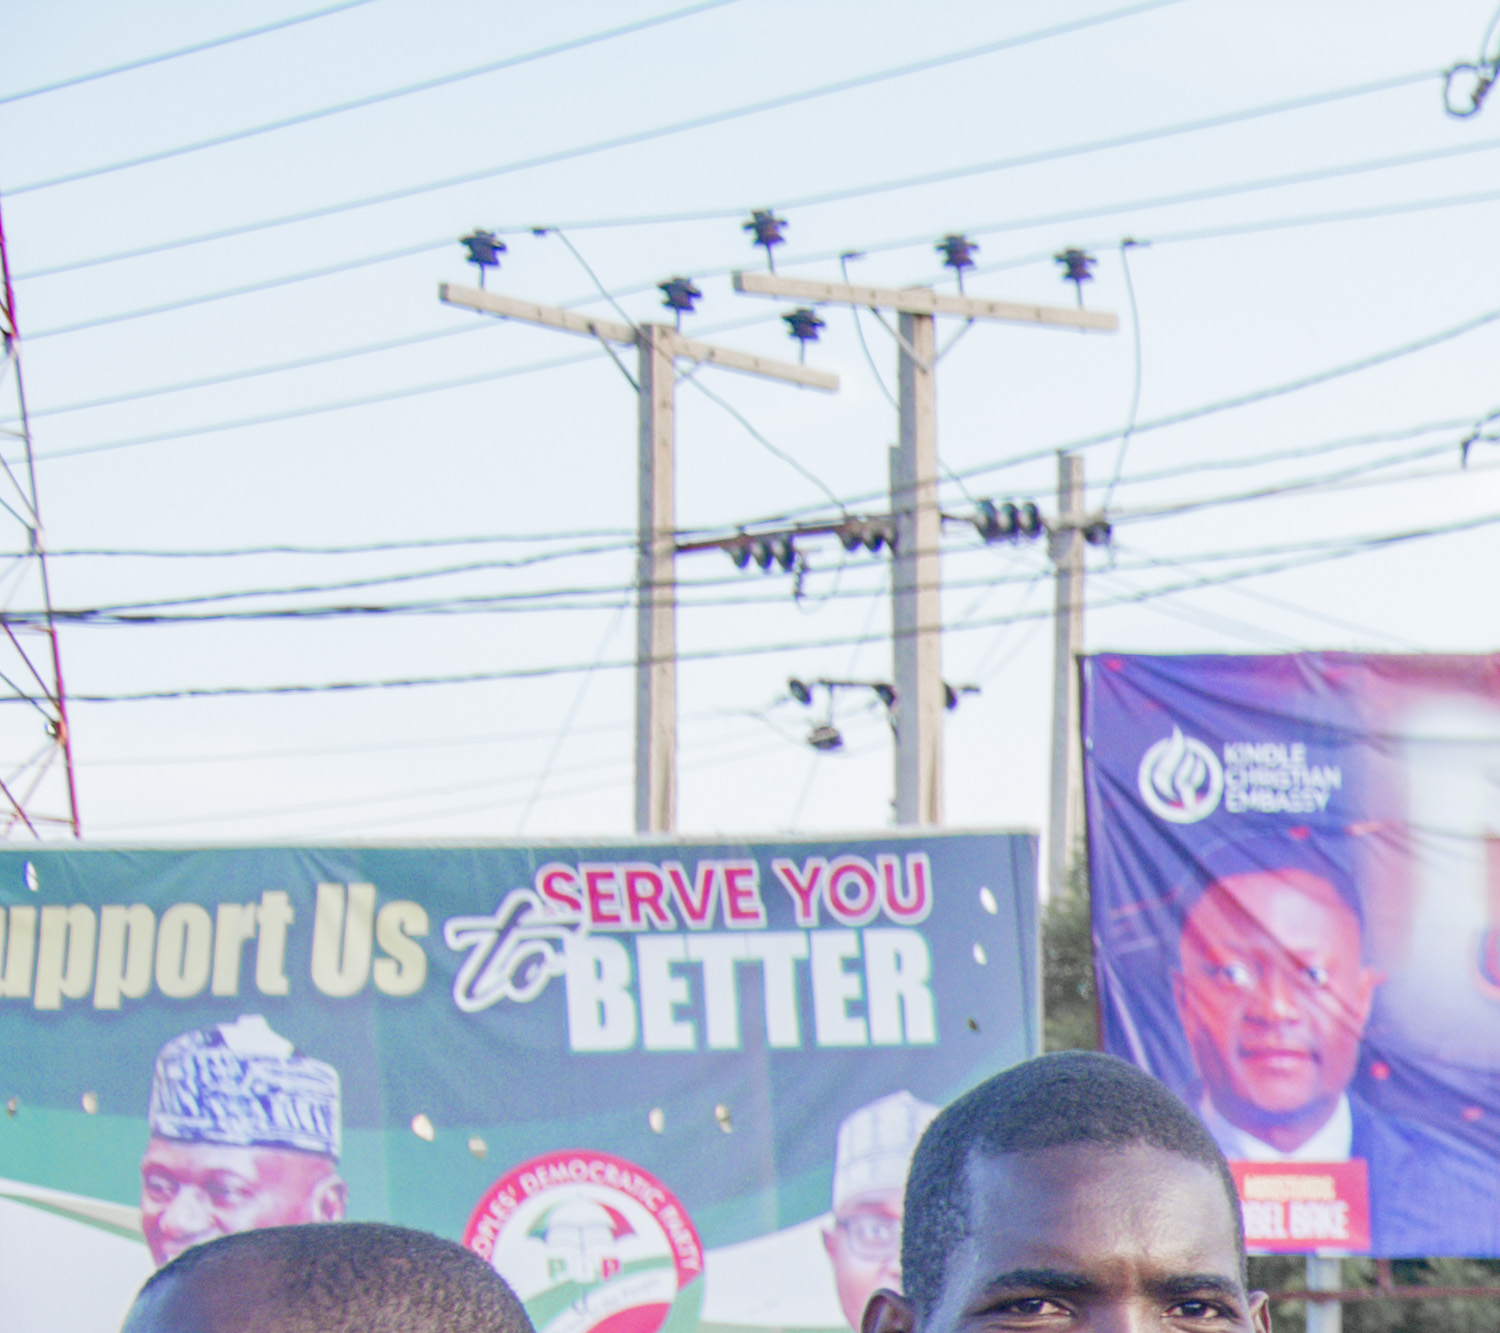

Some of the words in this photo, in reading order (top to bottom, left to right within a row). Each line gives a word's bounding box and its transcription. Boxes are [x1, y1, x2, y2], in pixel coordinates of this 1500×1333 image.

[311, 882, 428, 998] Us
[537, 860, 763, 932] SERVE
[775, 853, 932, 924] YOU
[445, 890, 590, 1012] to
[565, 929, 937, 1053] BETTER
[519, 1158, 667, 1213] DEMOCRATIC
